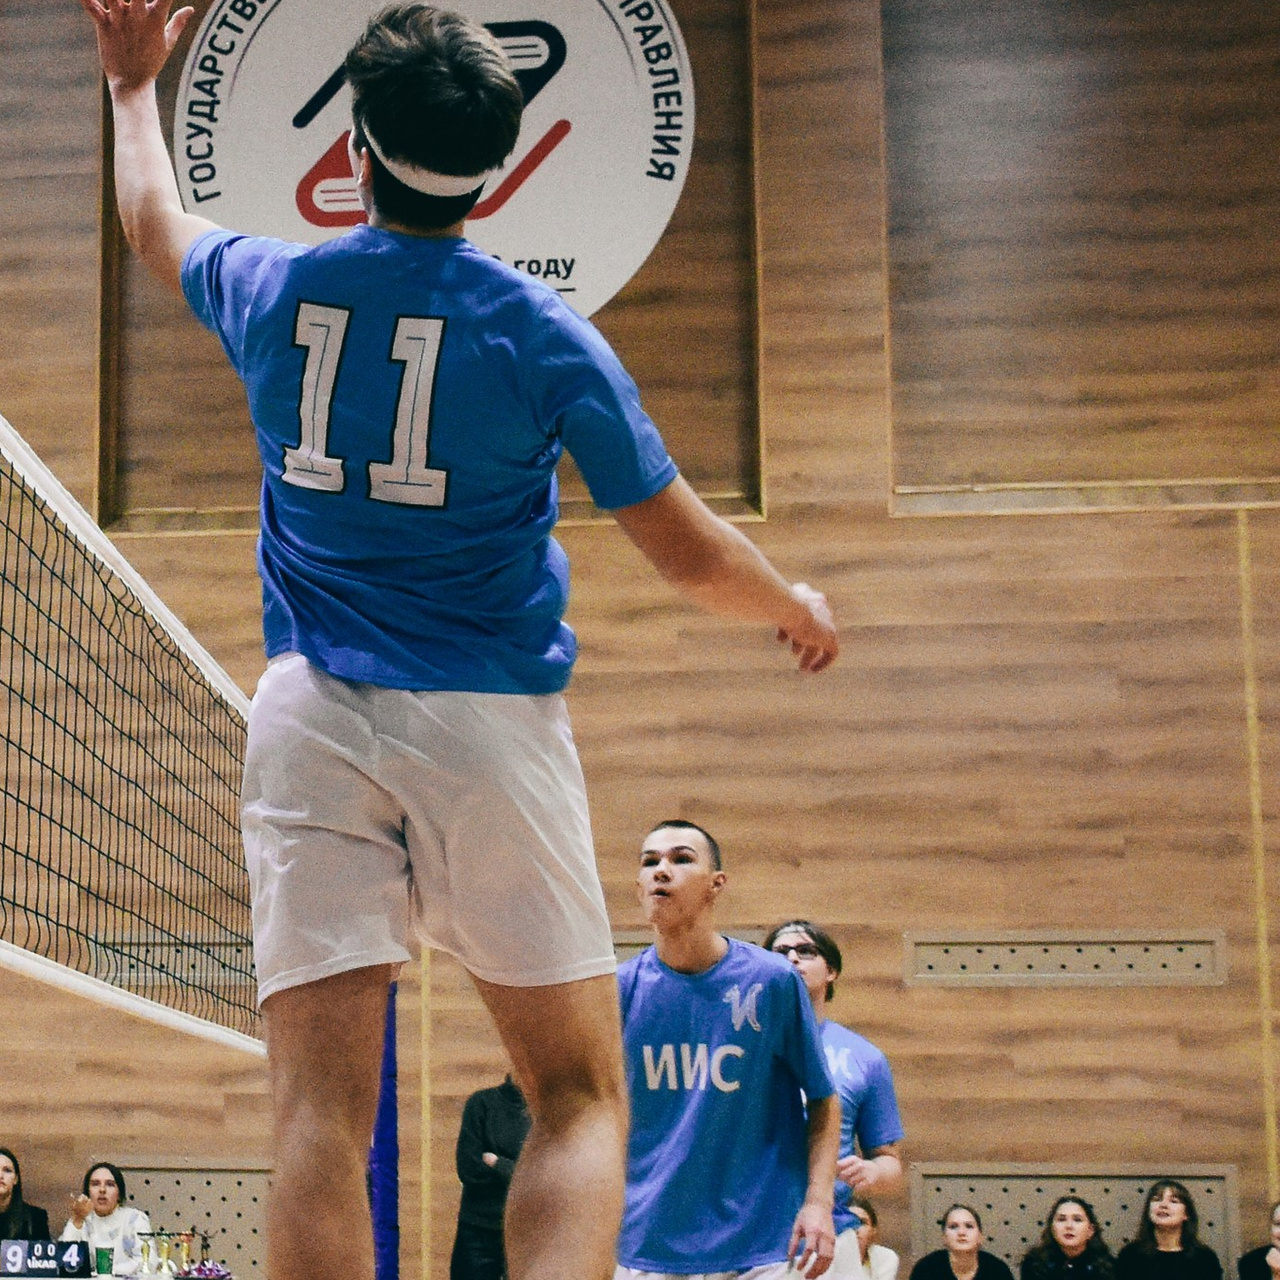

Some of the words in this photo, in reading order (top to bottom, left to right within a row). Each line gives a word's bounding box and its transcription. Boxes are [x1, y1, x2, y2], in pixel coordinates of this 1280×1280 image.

[281, 299, 447, 509] 11
[642, 1042, 745, 1093] ИИС
[7, 1245, 22, 1272] 9
[62, 1244, 80, 1266] 4
